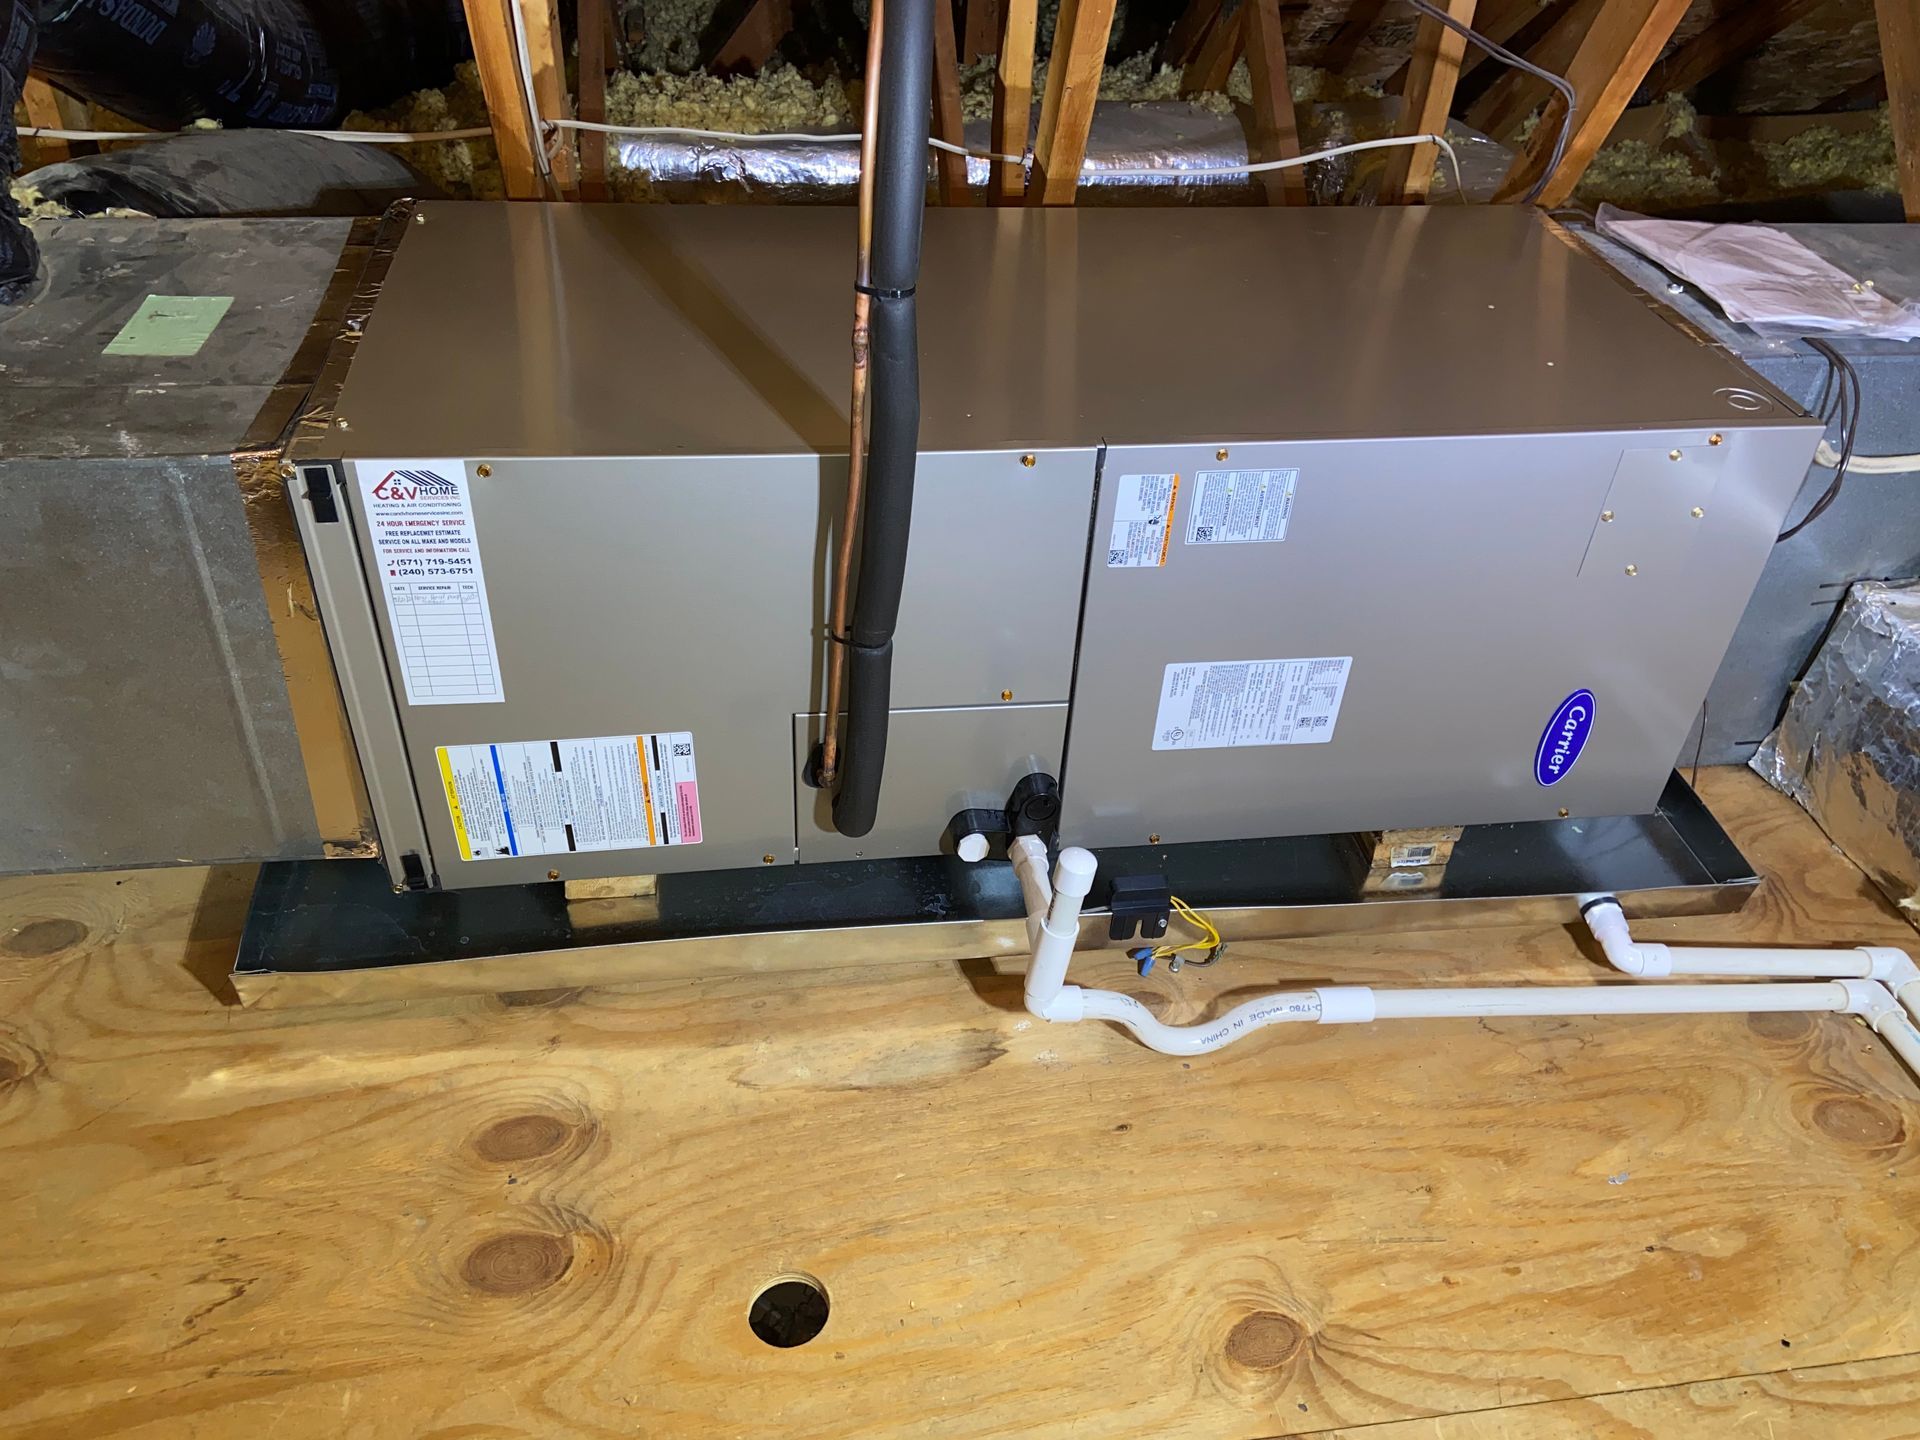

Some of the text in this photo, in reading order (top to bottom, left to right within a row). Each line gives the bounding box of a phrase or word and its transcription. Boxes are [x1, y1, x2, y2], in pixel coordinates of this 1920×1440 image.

[419, 486, 459, 495] HOME
[1548, 706, 1586, 774] Carrier
[1249, 1006, 1283, 1022] MADE
[1233, 1021, 1245, 1030] IN
[1200, 1029, 1230, 1045] CHINA
